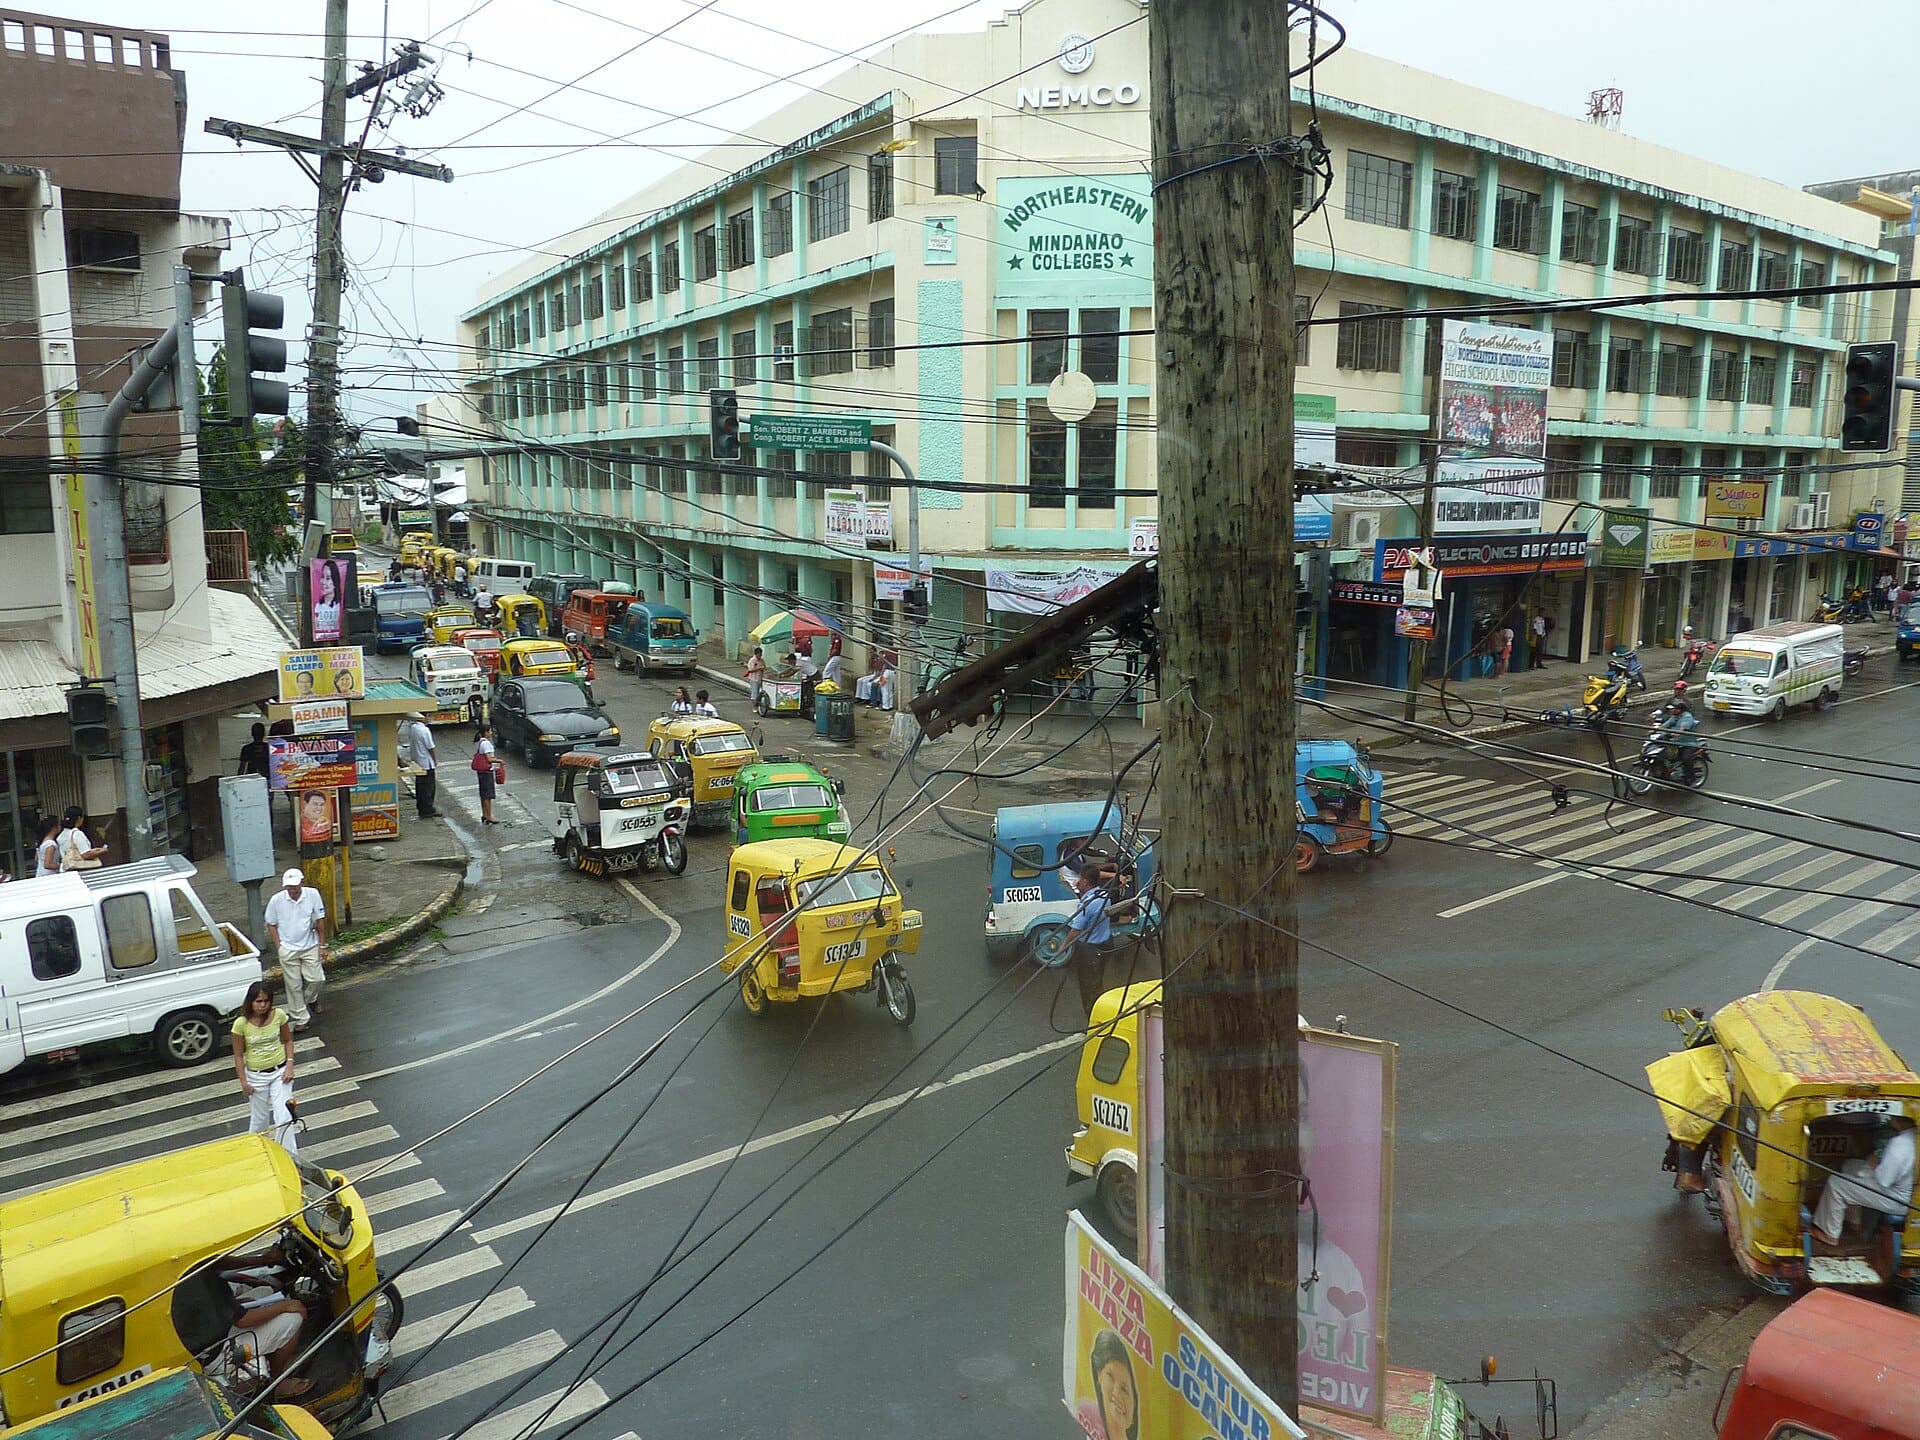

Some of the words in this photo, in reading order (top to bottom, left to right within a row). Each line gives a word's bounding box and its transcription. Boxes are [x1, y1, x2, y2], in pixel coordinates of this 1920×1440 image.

[1017, 83, 1141, 109] NEMCO
[1003, 185, 1148, 232] NORTHEASTERN
[1028, 233, 1123, 251] MINDANAO
[1032, 252, 1114, 270] COLLEGES
[1444, 362, 1466, 378] HIGH
[1467, 365, 1499, 381] SCHOOL
[1500, 368, 1516, 382] AND
[1517, 370, 1549, 385] COLLEGE
[753, 425, 769, 433] Sen.
[771, 426, 802, 434] ROBERT
[812, 428, 847, 436] BARBERS
[753, 434, 774, 442] Cong.
[833, 437, 868, 445] BARBERS
[1440, 545, 1518, 564] ELECTRONICS
[285, 662, 323, 671] OCAMPO
[289, 654, 319, 663] SATUR
[295, 706, 346, 721] ABAMIN
[287, 739, 337, 755] BAYANI
[892, 920, 898, 932] 5
[1090, 1247, 1146, 1325] LIZA
[1080, 1267, 1154, 1368] MAZA
[1179, 1333, 1271, 1440] SATUR
